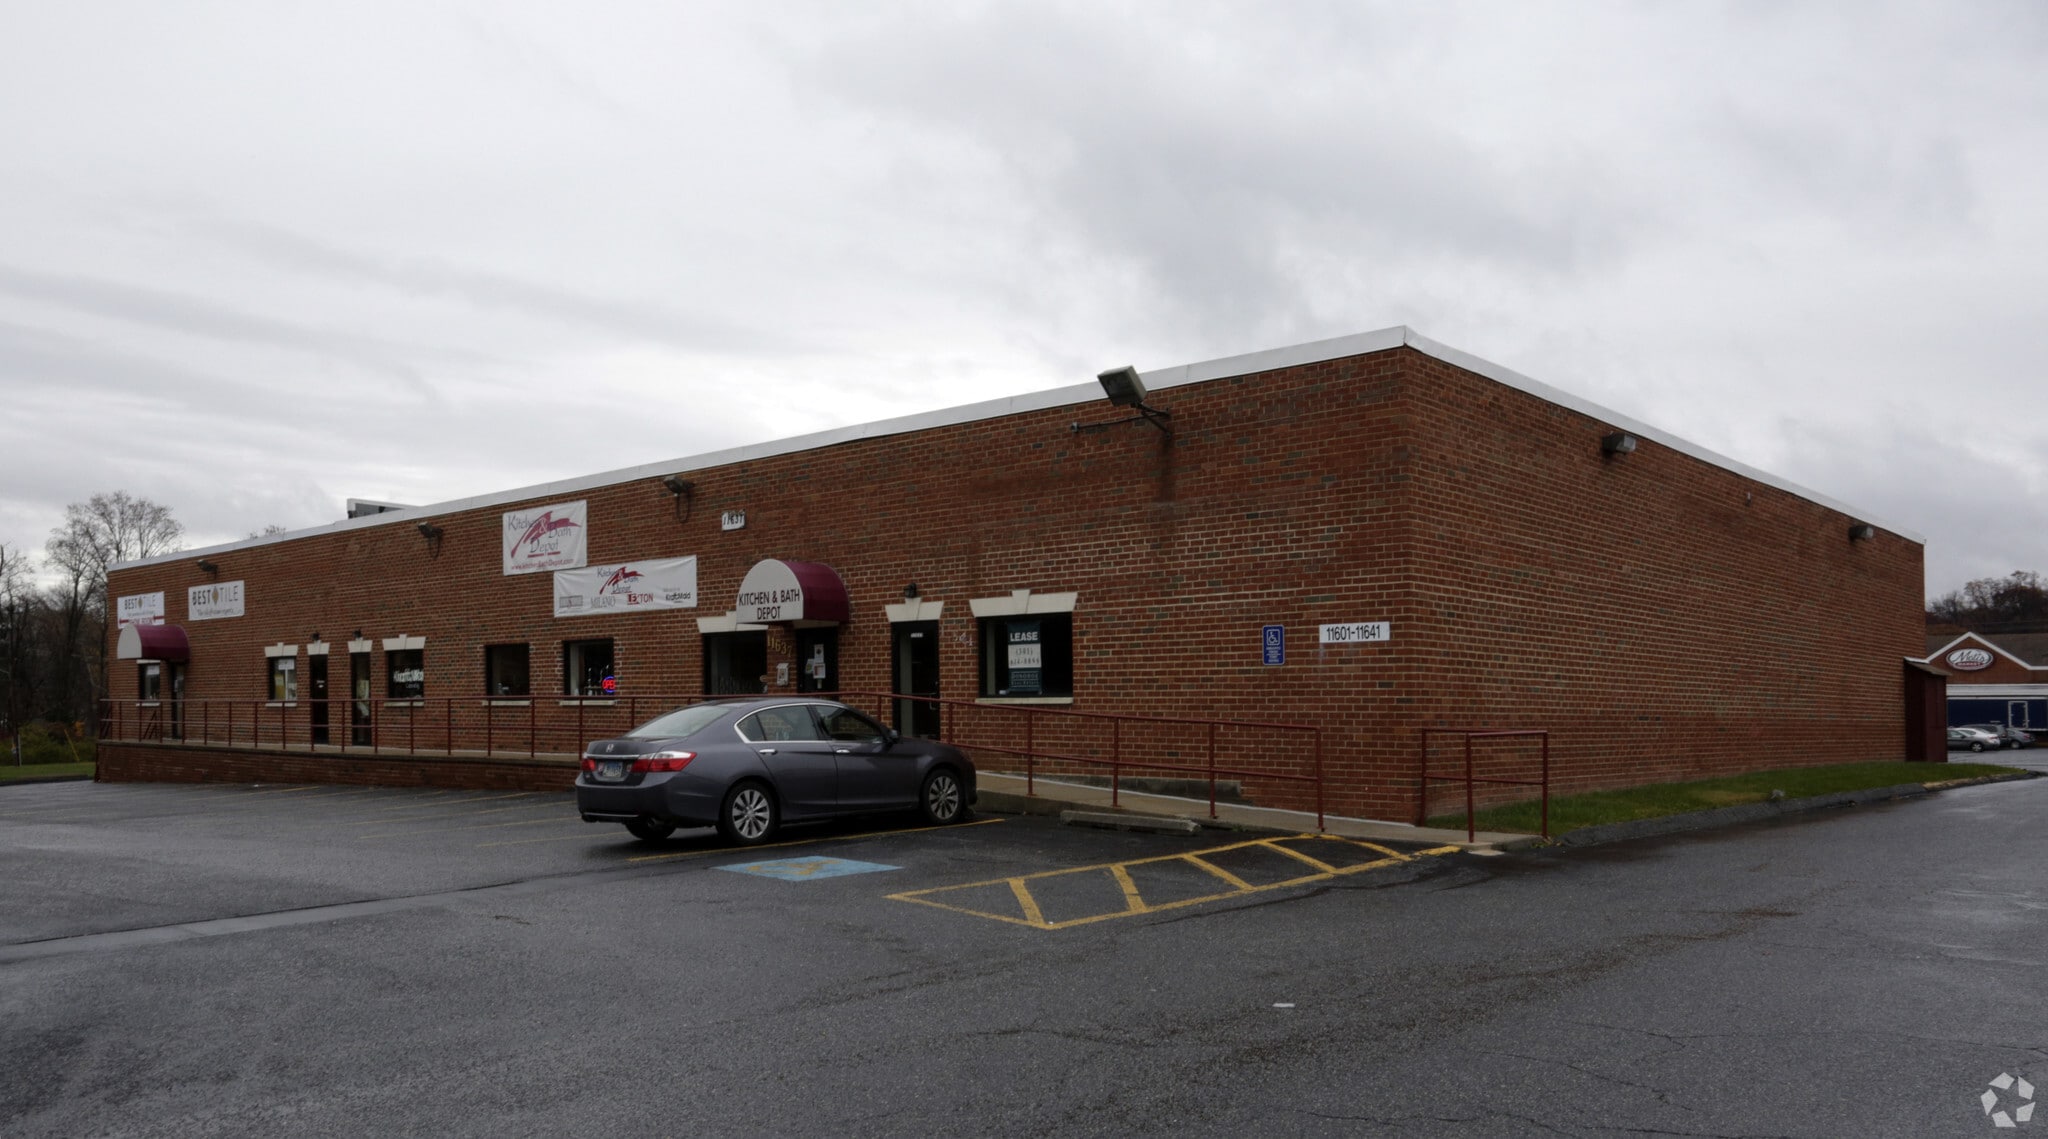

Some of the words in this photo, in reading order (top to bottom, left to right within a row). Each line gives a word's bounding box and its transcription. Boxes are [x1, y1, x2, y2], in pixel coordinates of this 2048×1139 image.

[508, 513, 535, 531] Kitche
[529, 537, 559, 555] Depot
[124, 597, 137, 610] BEST
[192, 589, 211, 605] BEST
[219, 585, 238, 602] TILE
[738, 591, 769, 606] KITCHEN
[772, 591, 778, 604] &
[780, 589, 799, 602] BATH
[757, 606, 780, 620] DEPOT
[1010, 631, 1038, 642] LEASE
[1326, 624, 1381, 641] 11601-11641
